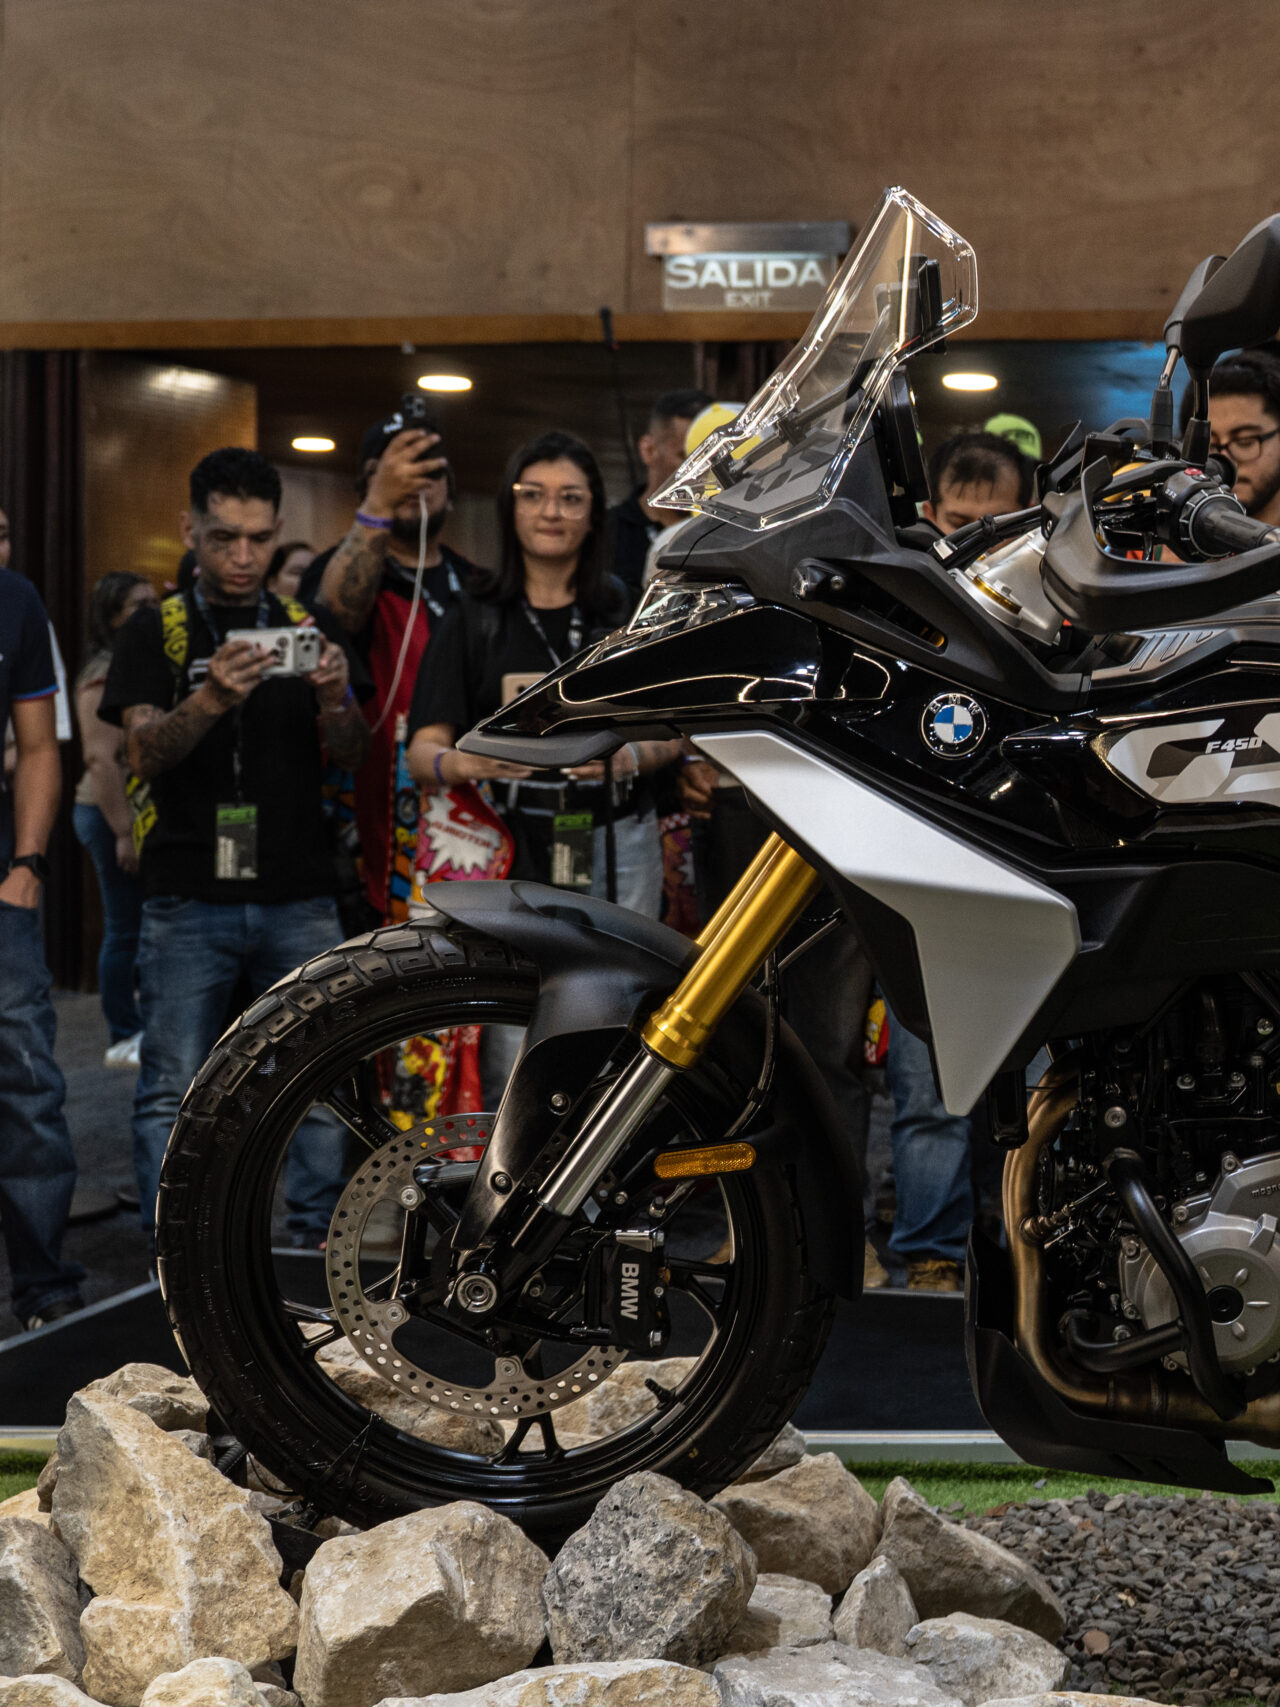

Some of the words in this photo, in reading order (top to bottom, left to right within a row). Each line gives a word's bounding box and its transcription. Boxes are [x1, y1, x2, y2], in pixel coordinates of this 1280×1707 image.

[665, 256, 826, 289] SALIDA
[724, 291, 774, 308] EXIT
[1205, 736, 1264, 755] F450
[620, 1263, 640, 1320] BMW
